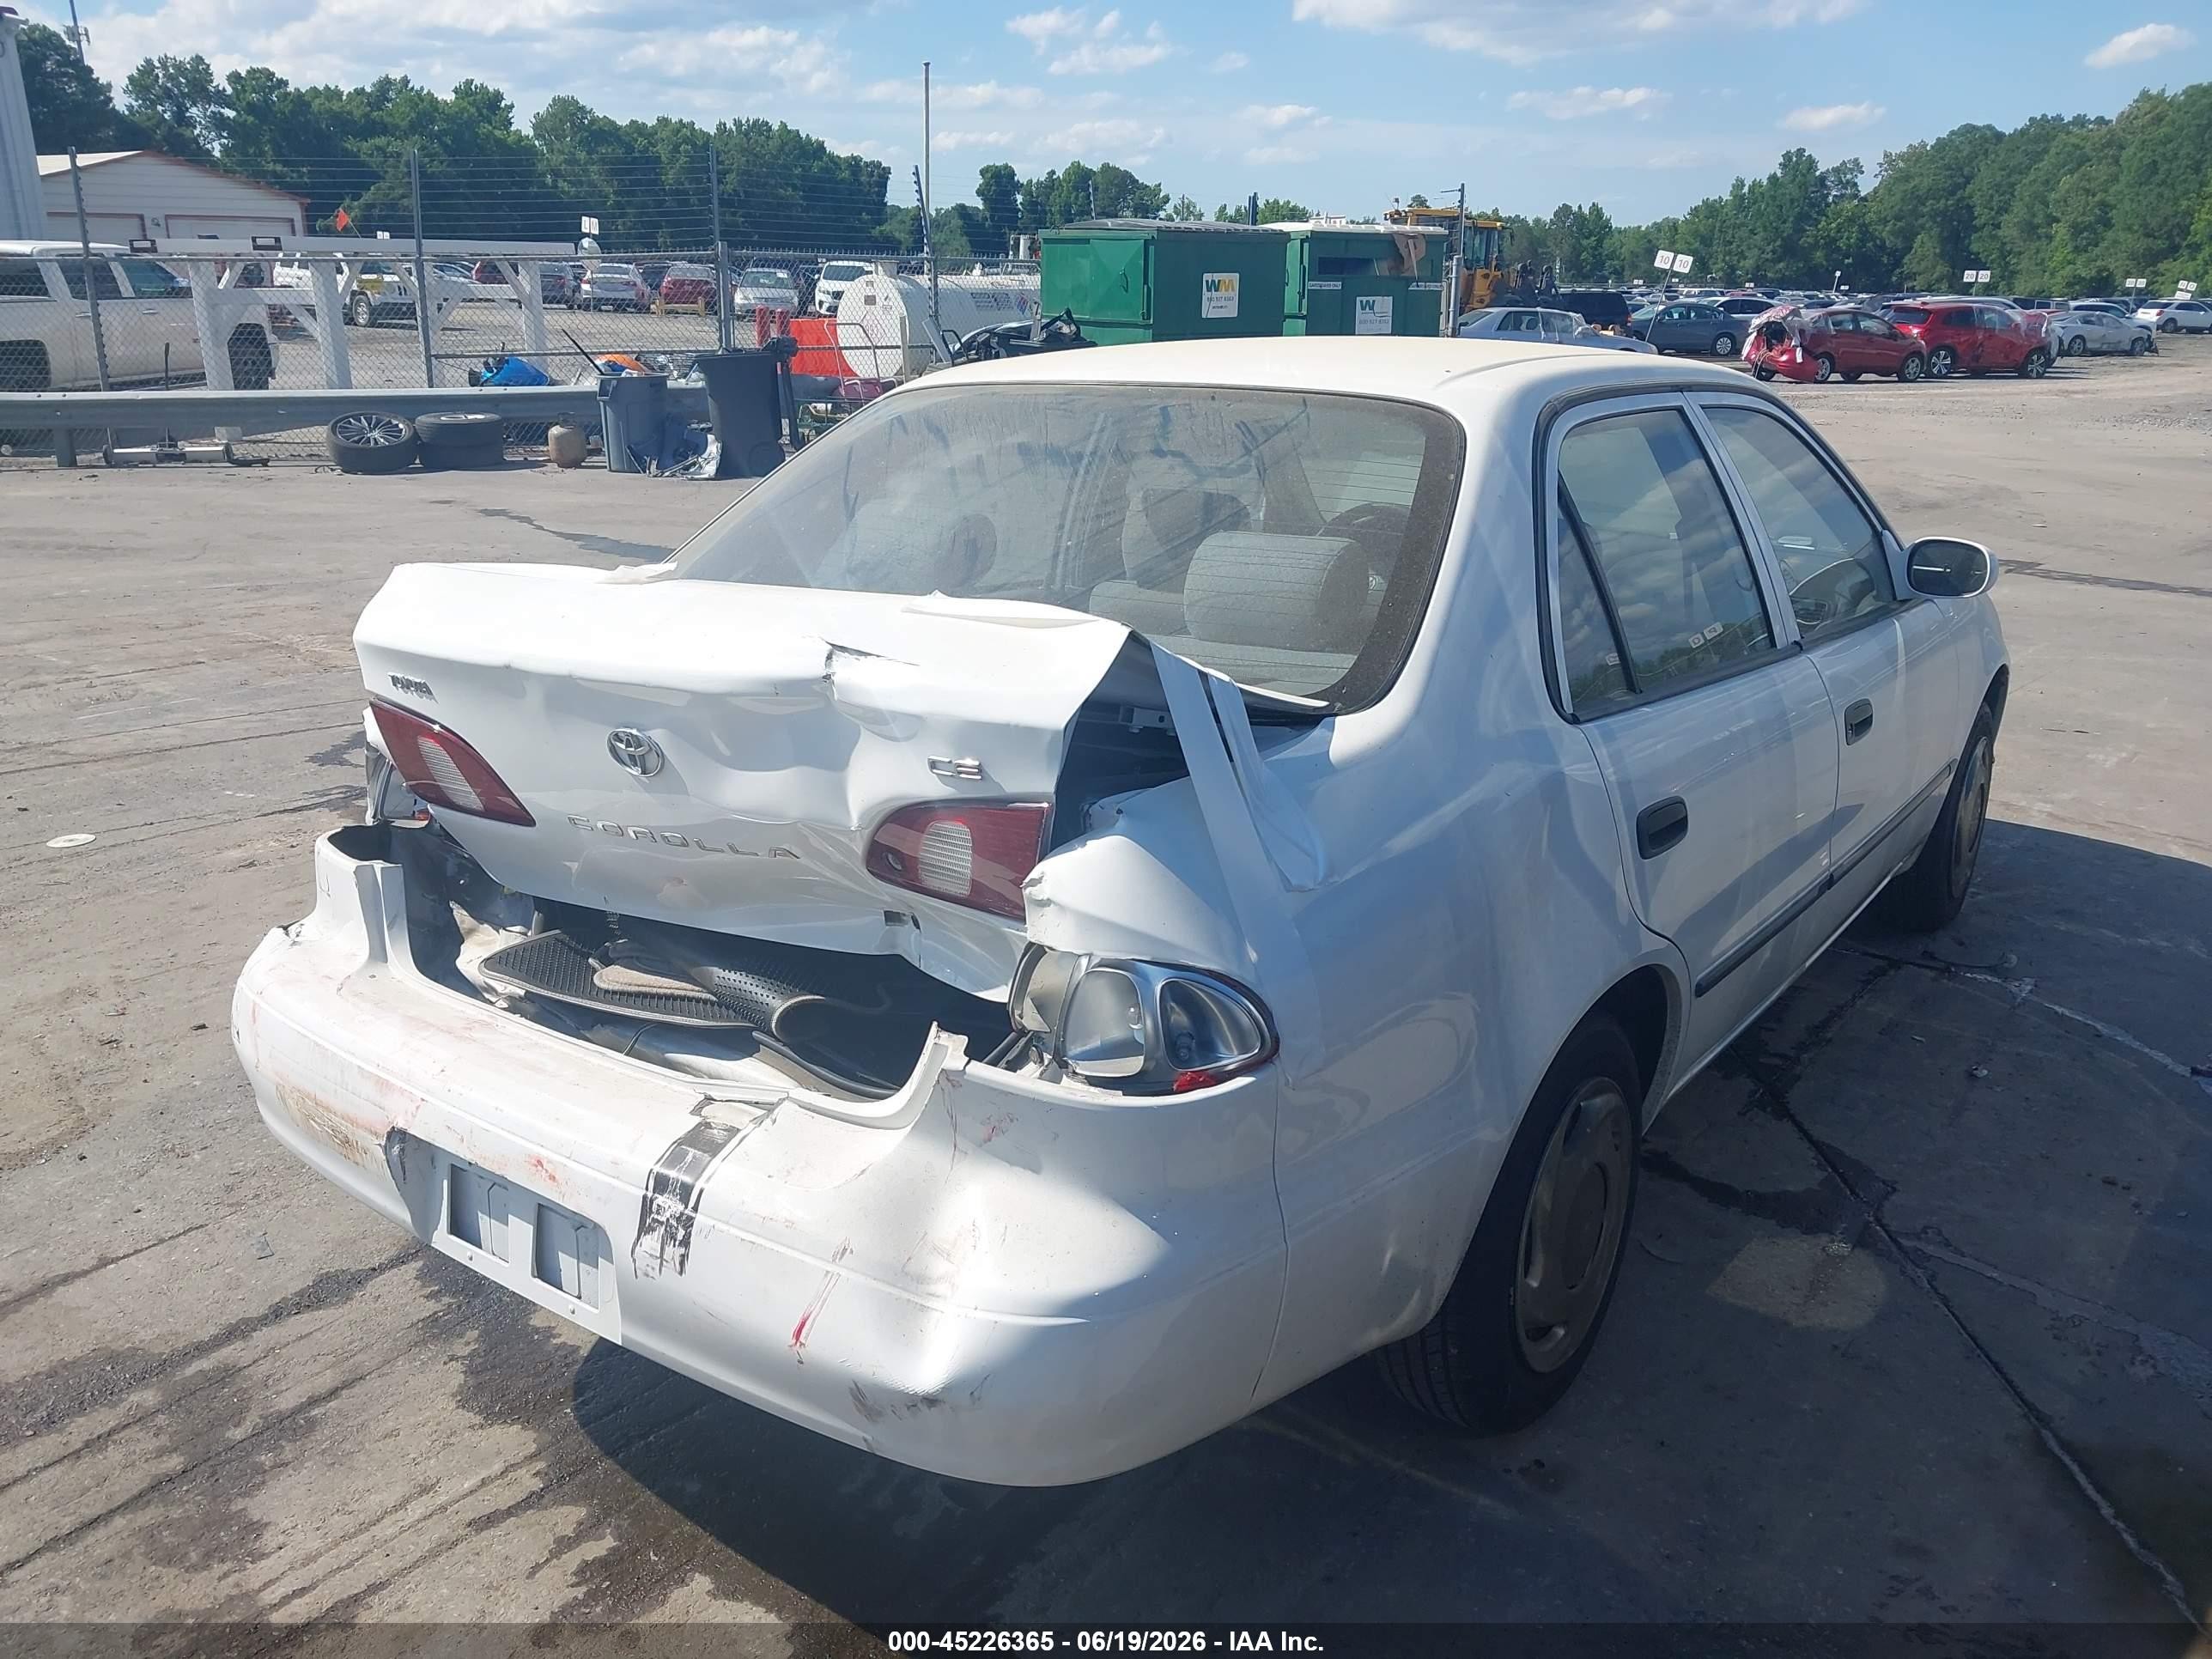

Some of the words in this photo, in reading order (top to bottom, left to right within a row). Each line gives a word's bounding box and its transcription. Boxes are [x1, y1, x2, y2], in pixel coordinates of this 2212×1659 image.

[1659, 255, 1670, 265] 10
[1678, 259, 1689, 269] 10
[1205, 278, 1236, 293] WM
[567, 814, 801, 860] COROLLA
